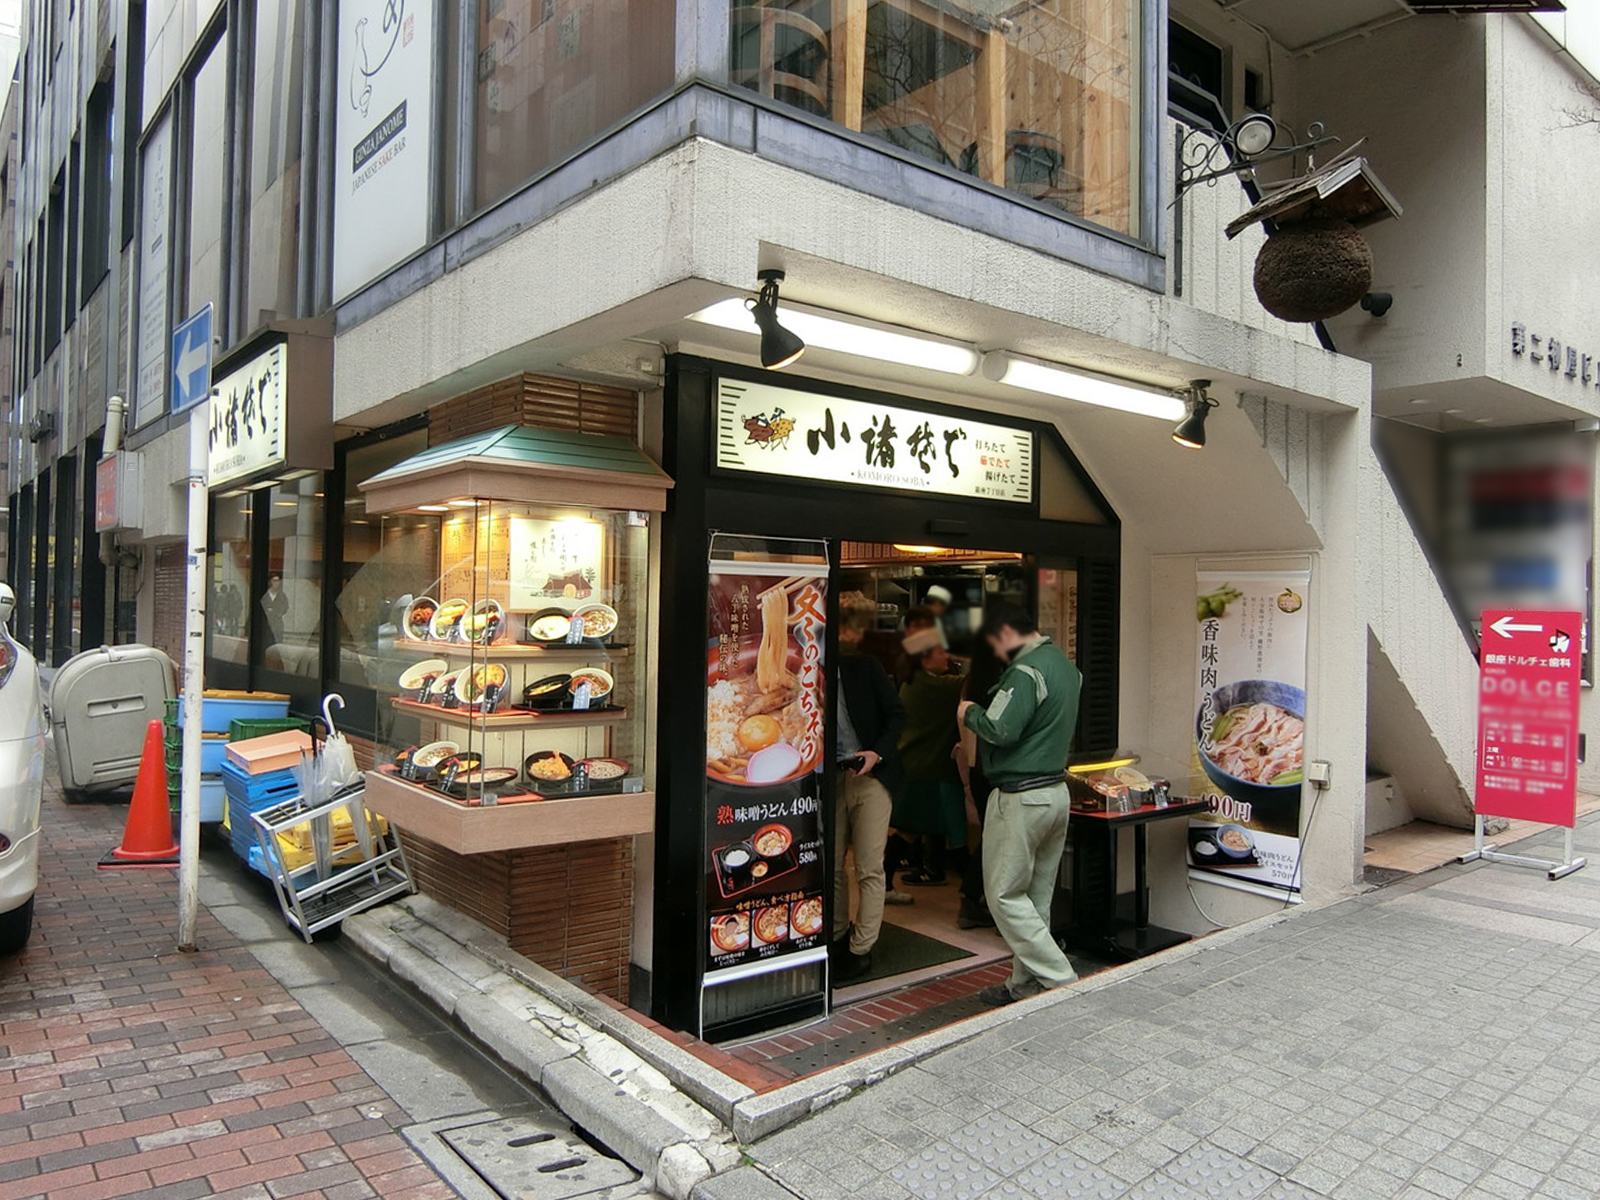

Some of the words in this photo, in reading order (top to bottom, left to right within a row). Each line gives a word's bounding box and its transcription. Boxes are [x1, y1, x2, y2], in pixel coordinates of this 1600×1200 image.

[355, 138, 375, 164] GINZA
[374, 108, 405, 151] JANOME
[351, 161, 378, 196] JAPANESE
[378, 146, 393, 168] SAKE
[393, 136, 407, 157] BAR
[975, 439, 1006, 454] 打ちたて
[857, 469, 901, 485] KOMORO
[901, 474, 926, 488] SOBA
[985, 471, 1016, 484] 揚げたて
[787, 585, 827, 760] 冬のごちそう
[1485, 654, 1572, 669] 銀座ドルチェ歯科
[1199, 619, 1221, 752] 香味肉うどん
[1482, 676, 1570, 699] DOLCE
